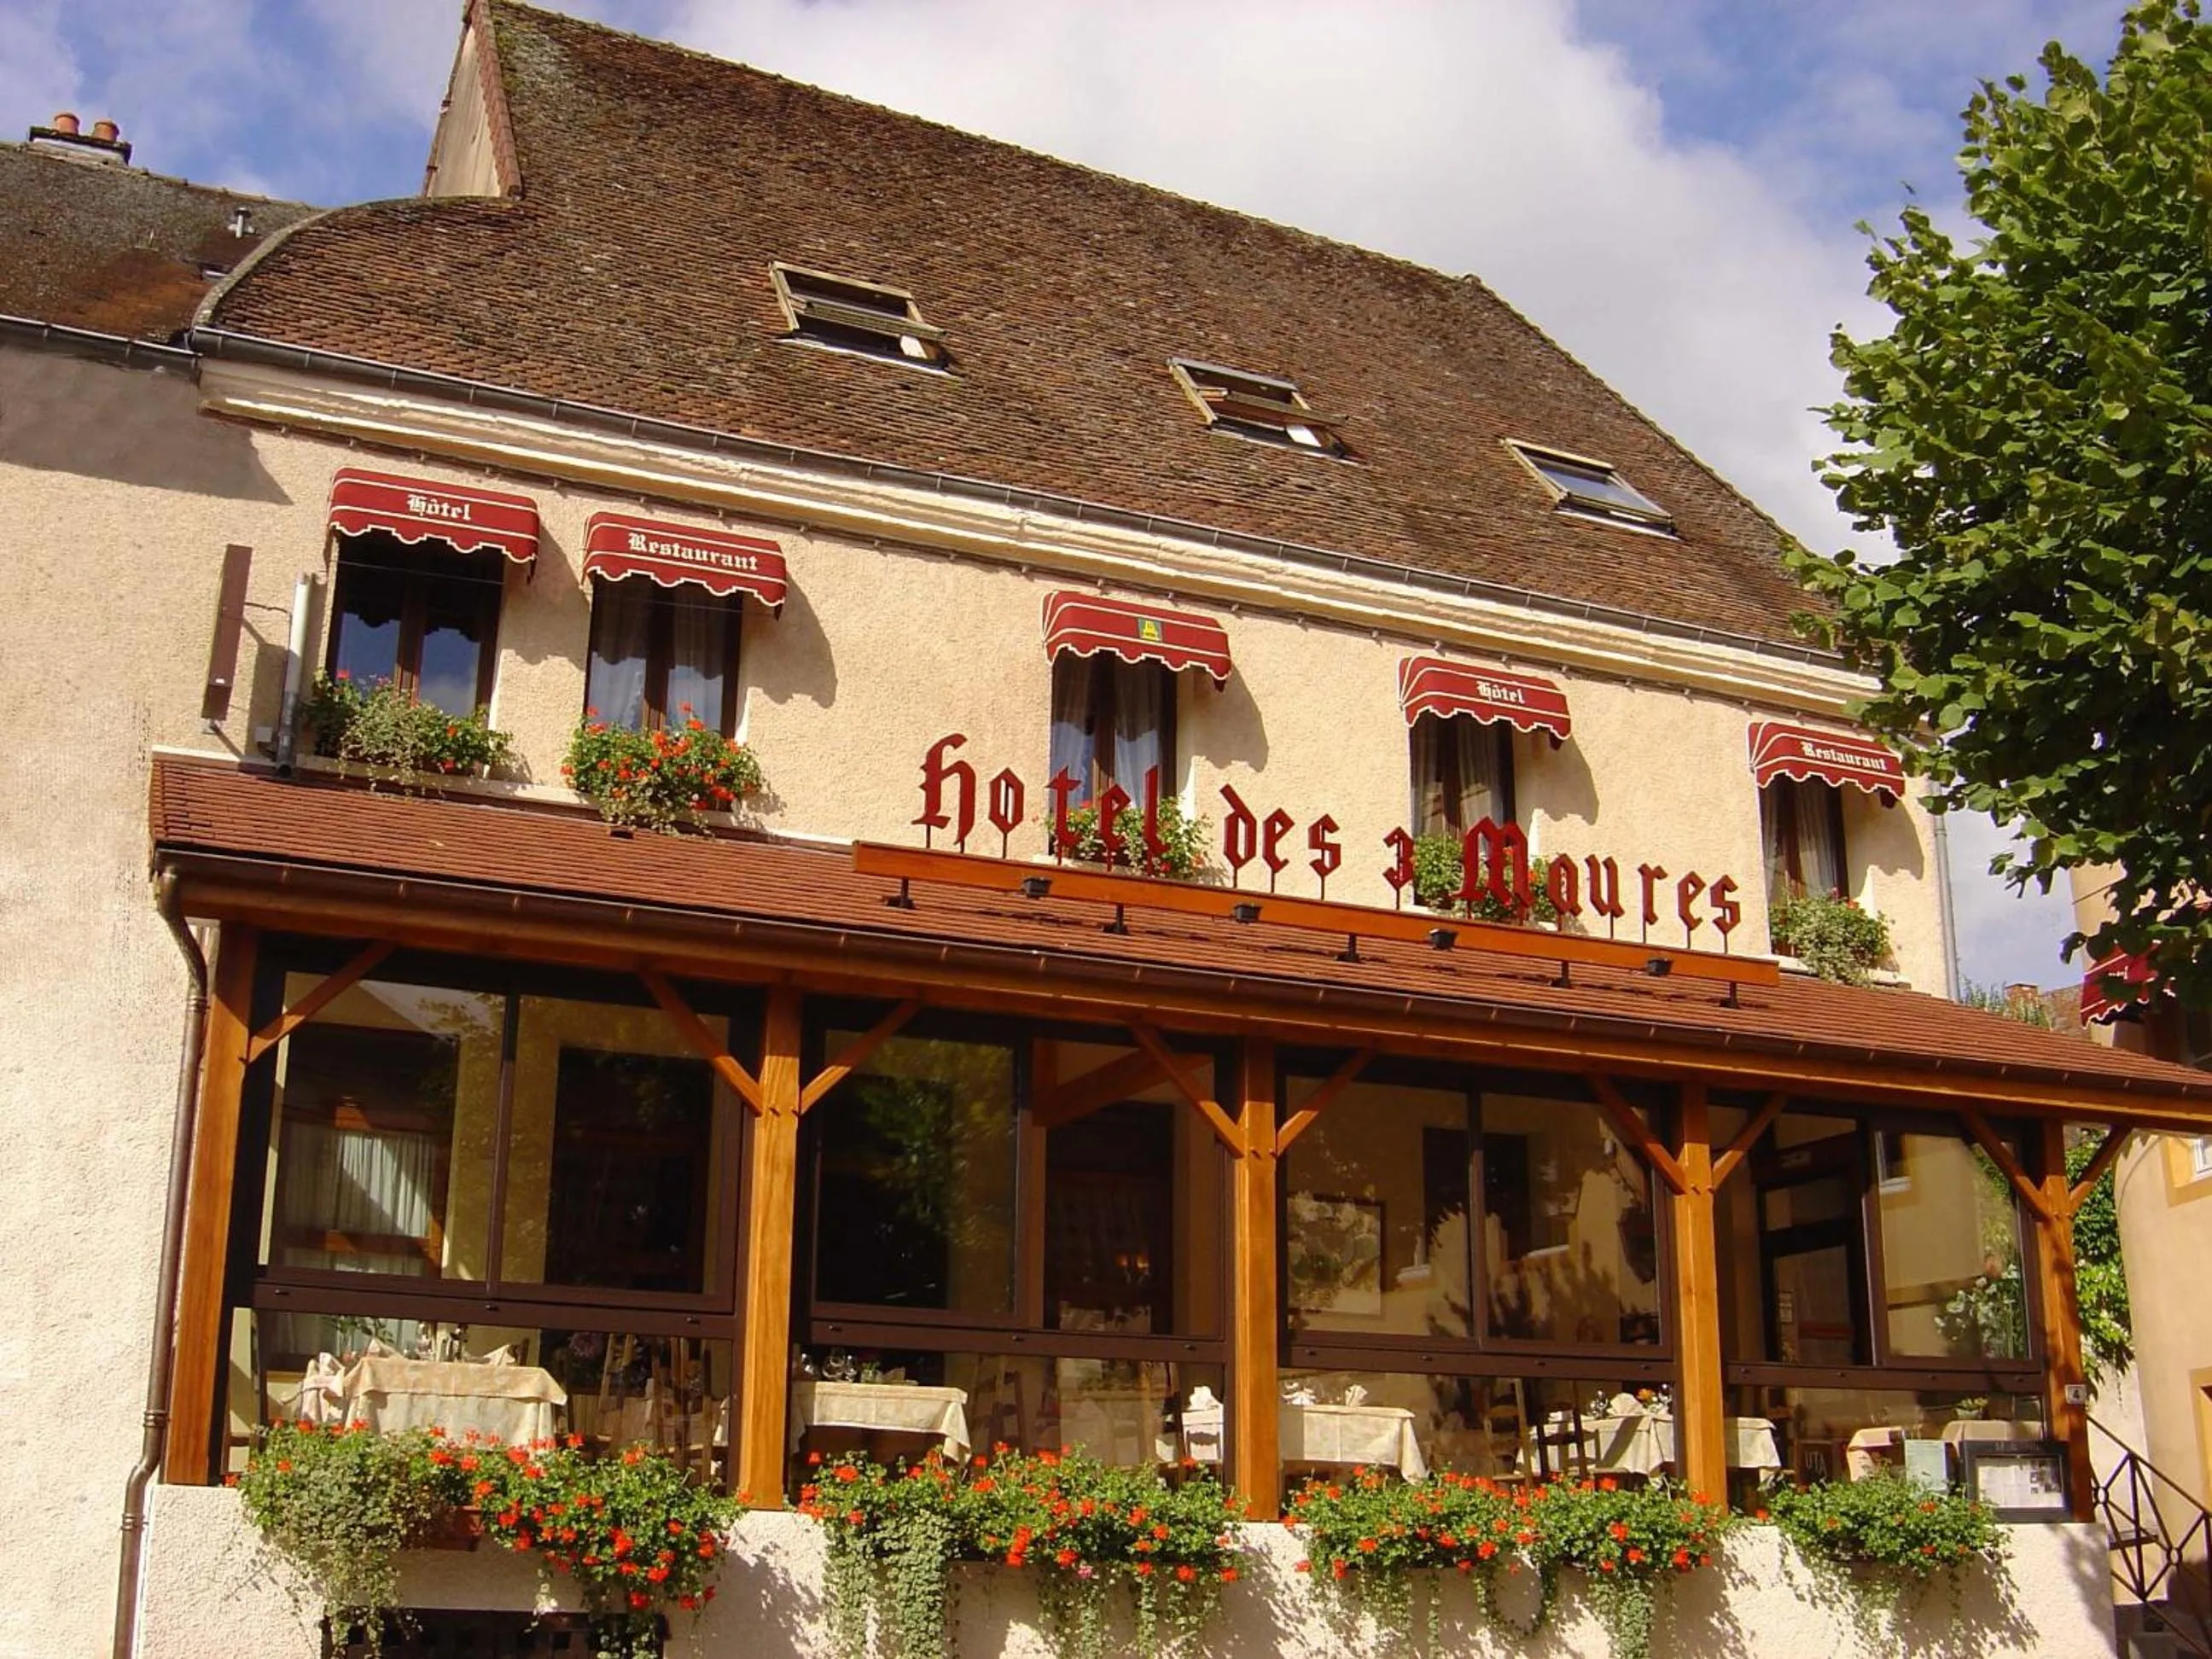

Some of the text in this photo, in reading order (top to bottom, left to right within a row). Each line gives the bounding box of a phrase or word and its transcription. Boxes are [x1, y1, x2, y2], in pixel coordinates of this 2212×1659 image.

[406, 493, 472, 521] Hôtel
[628, 532, 759, 571] Restaurant
[1476, 680, 1526, 704] Hôtel
[1800, 741, 1888, 771] Restaurant
[911, 732, 1742, 935] Hotel des 3 Maures
